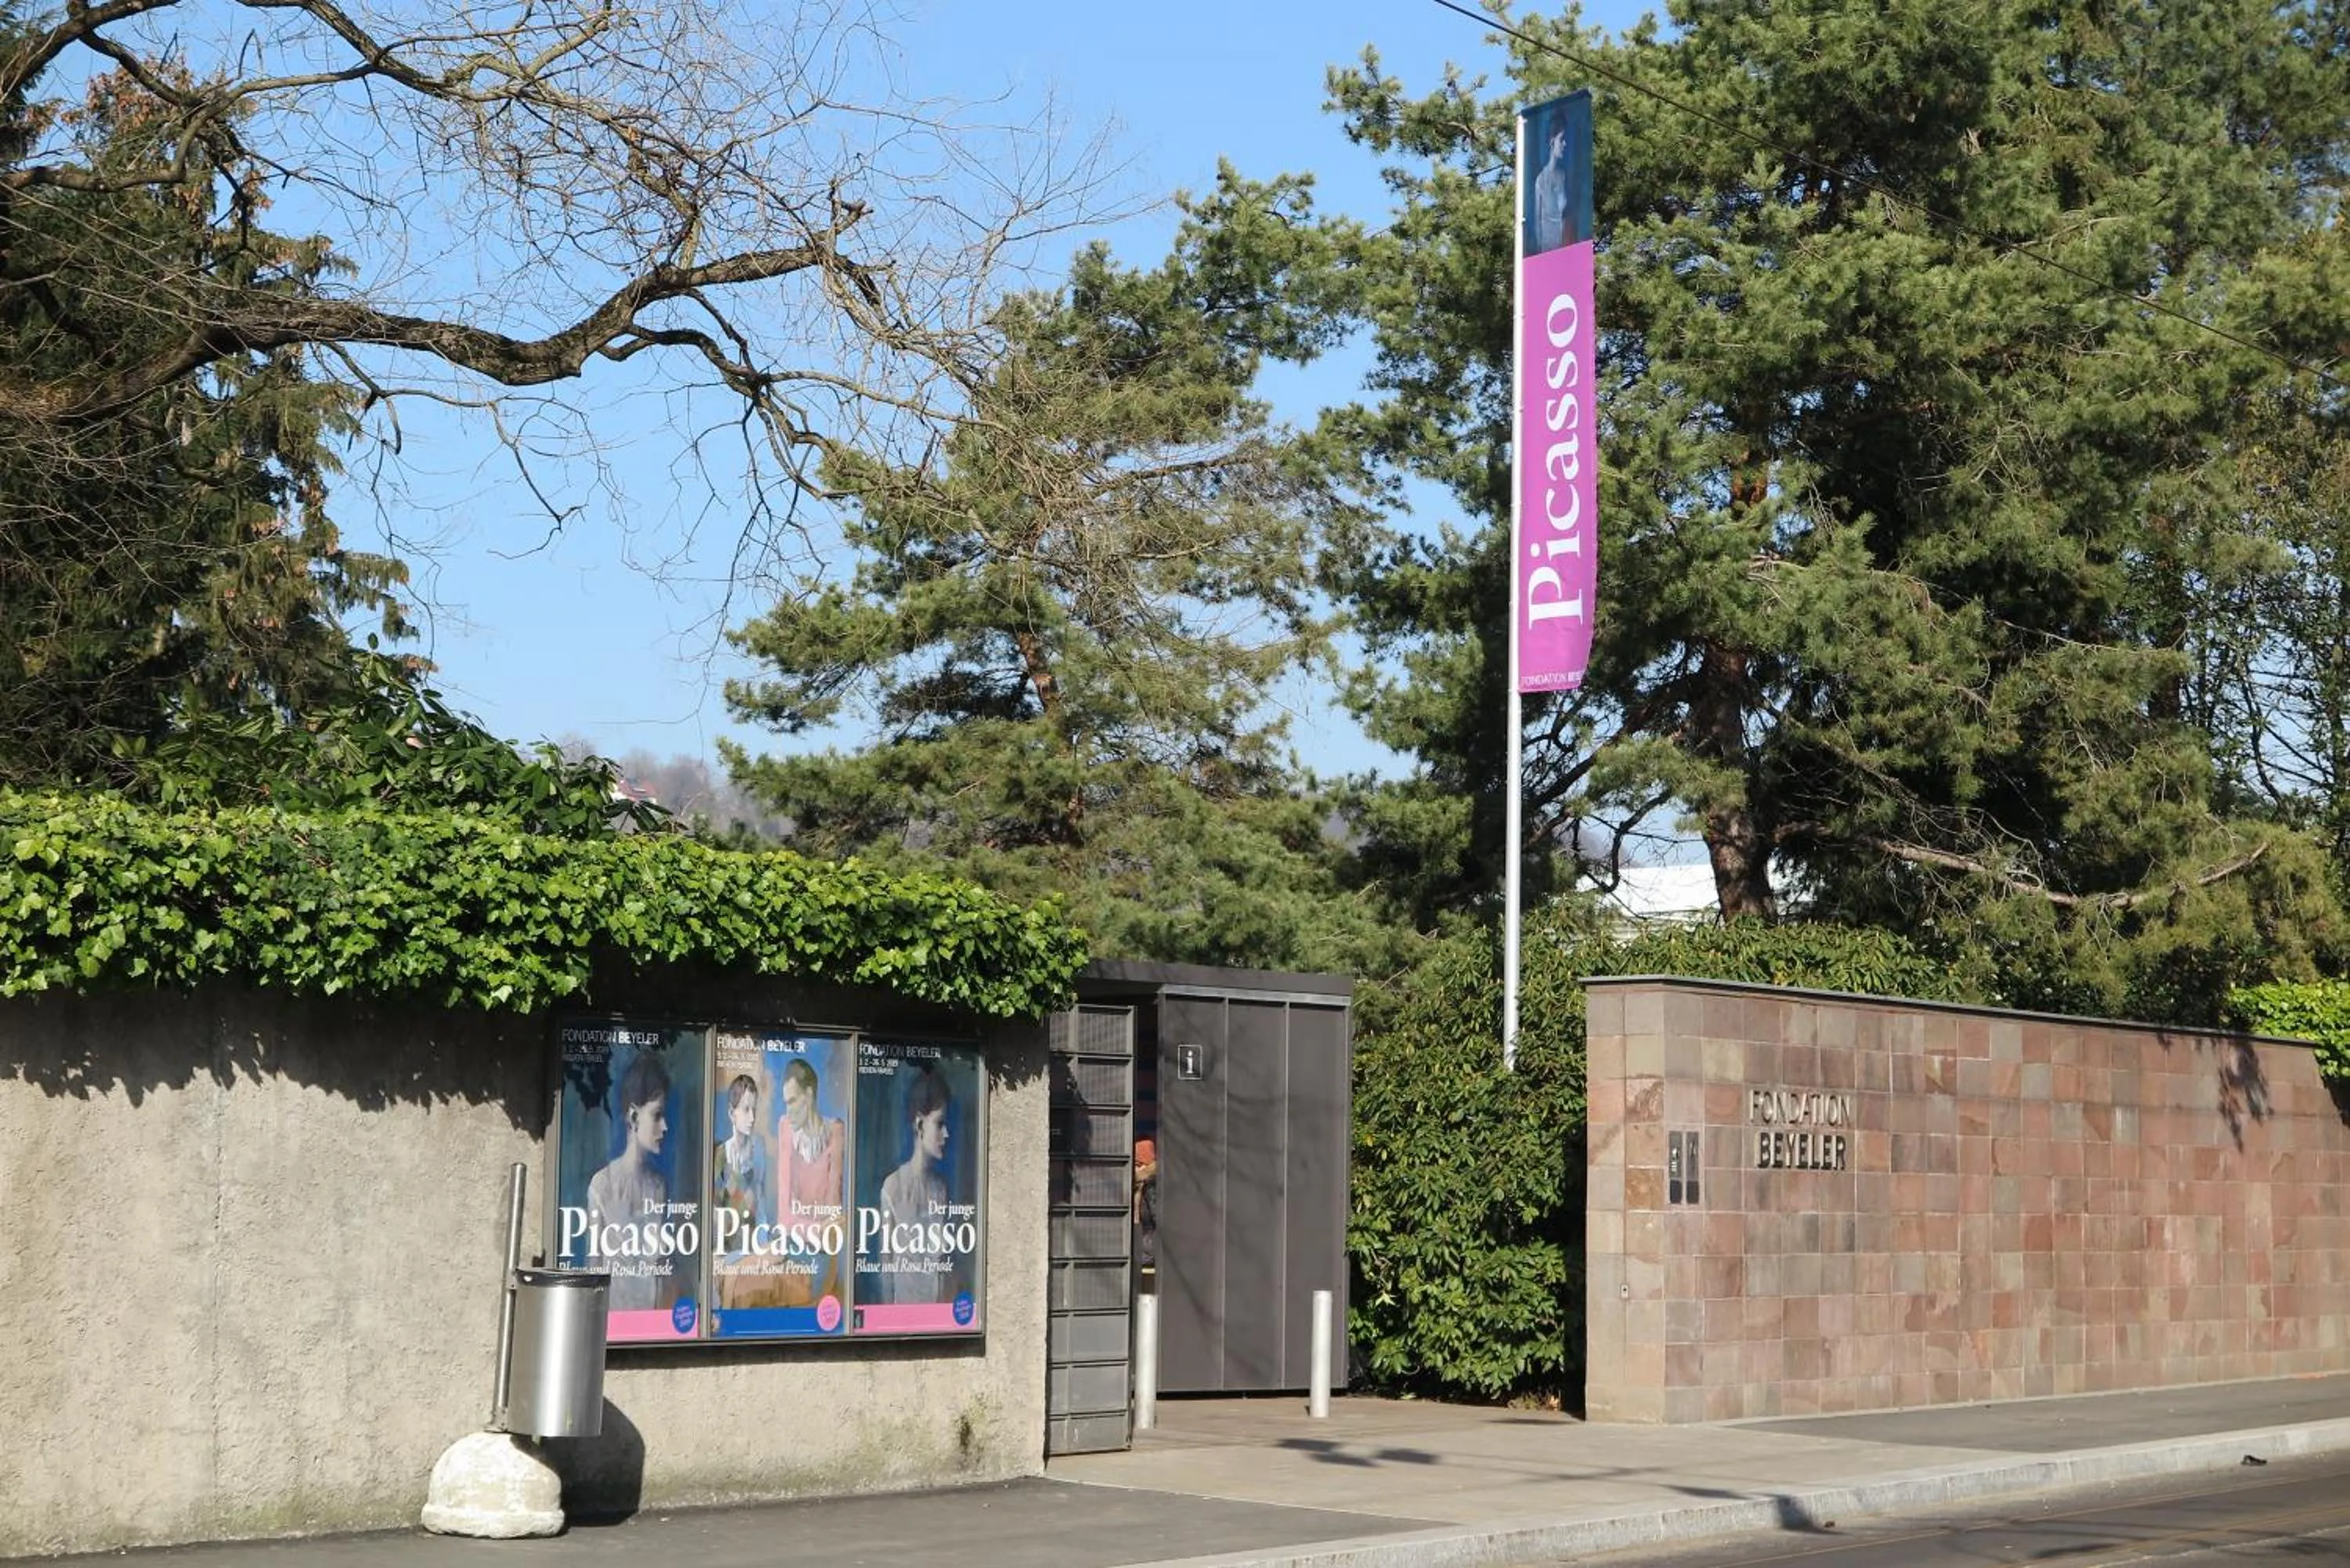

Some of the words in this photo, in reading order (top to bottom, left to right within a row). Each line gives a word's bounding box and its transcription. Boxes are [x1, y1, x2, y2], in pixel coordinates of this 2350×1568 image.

[1528, 294, 1583, 630] Picasso
[618, 1031, 659, 1044] BEYELER
[1749, 1089, 1849, 1126] FONDATION
[1755, 1133, 1846, 1170] BEYELER
[643, 1198, 664, 1214] Der
[665, 1199, 698, 1219] junge
[791, 1200, 812, 1215] Der
[812, 1201, 842, 1220] junge
[928, 1200, 946, 1215] Der
[947, 1201, 975, 1220] junge
[559, 1207, 699, 1257] Picasso
[714, 1207, 844, 1255] Picasso
[855, 1207, 976, 1254] Picasso
[611, 1262, 635, 1277] Rosa
[636, 1259, 674, 1276] Periode
[713, 1260, 740, 1275] Blaue
[741, 1259, 761, 1275] und
[761, 1259, 784, 1275] Rosa
[785, 1259, 819, 1275] Periode
[855, 1256, 880, 1273] Blaue
[881, 1256, 900, 1273] und
[900, 1256, 921, 1273] Rosa
[921, 1255, 953, 1273] Periode
